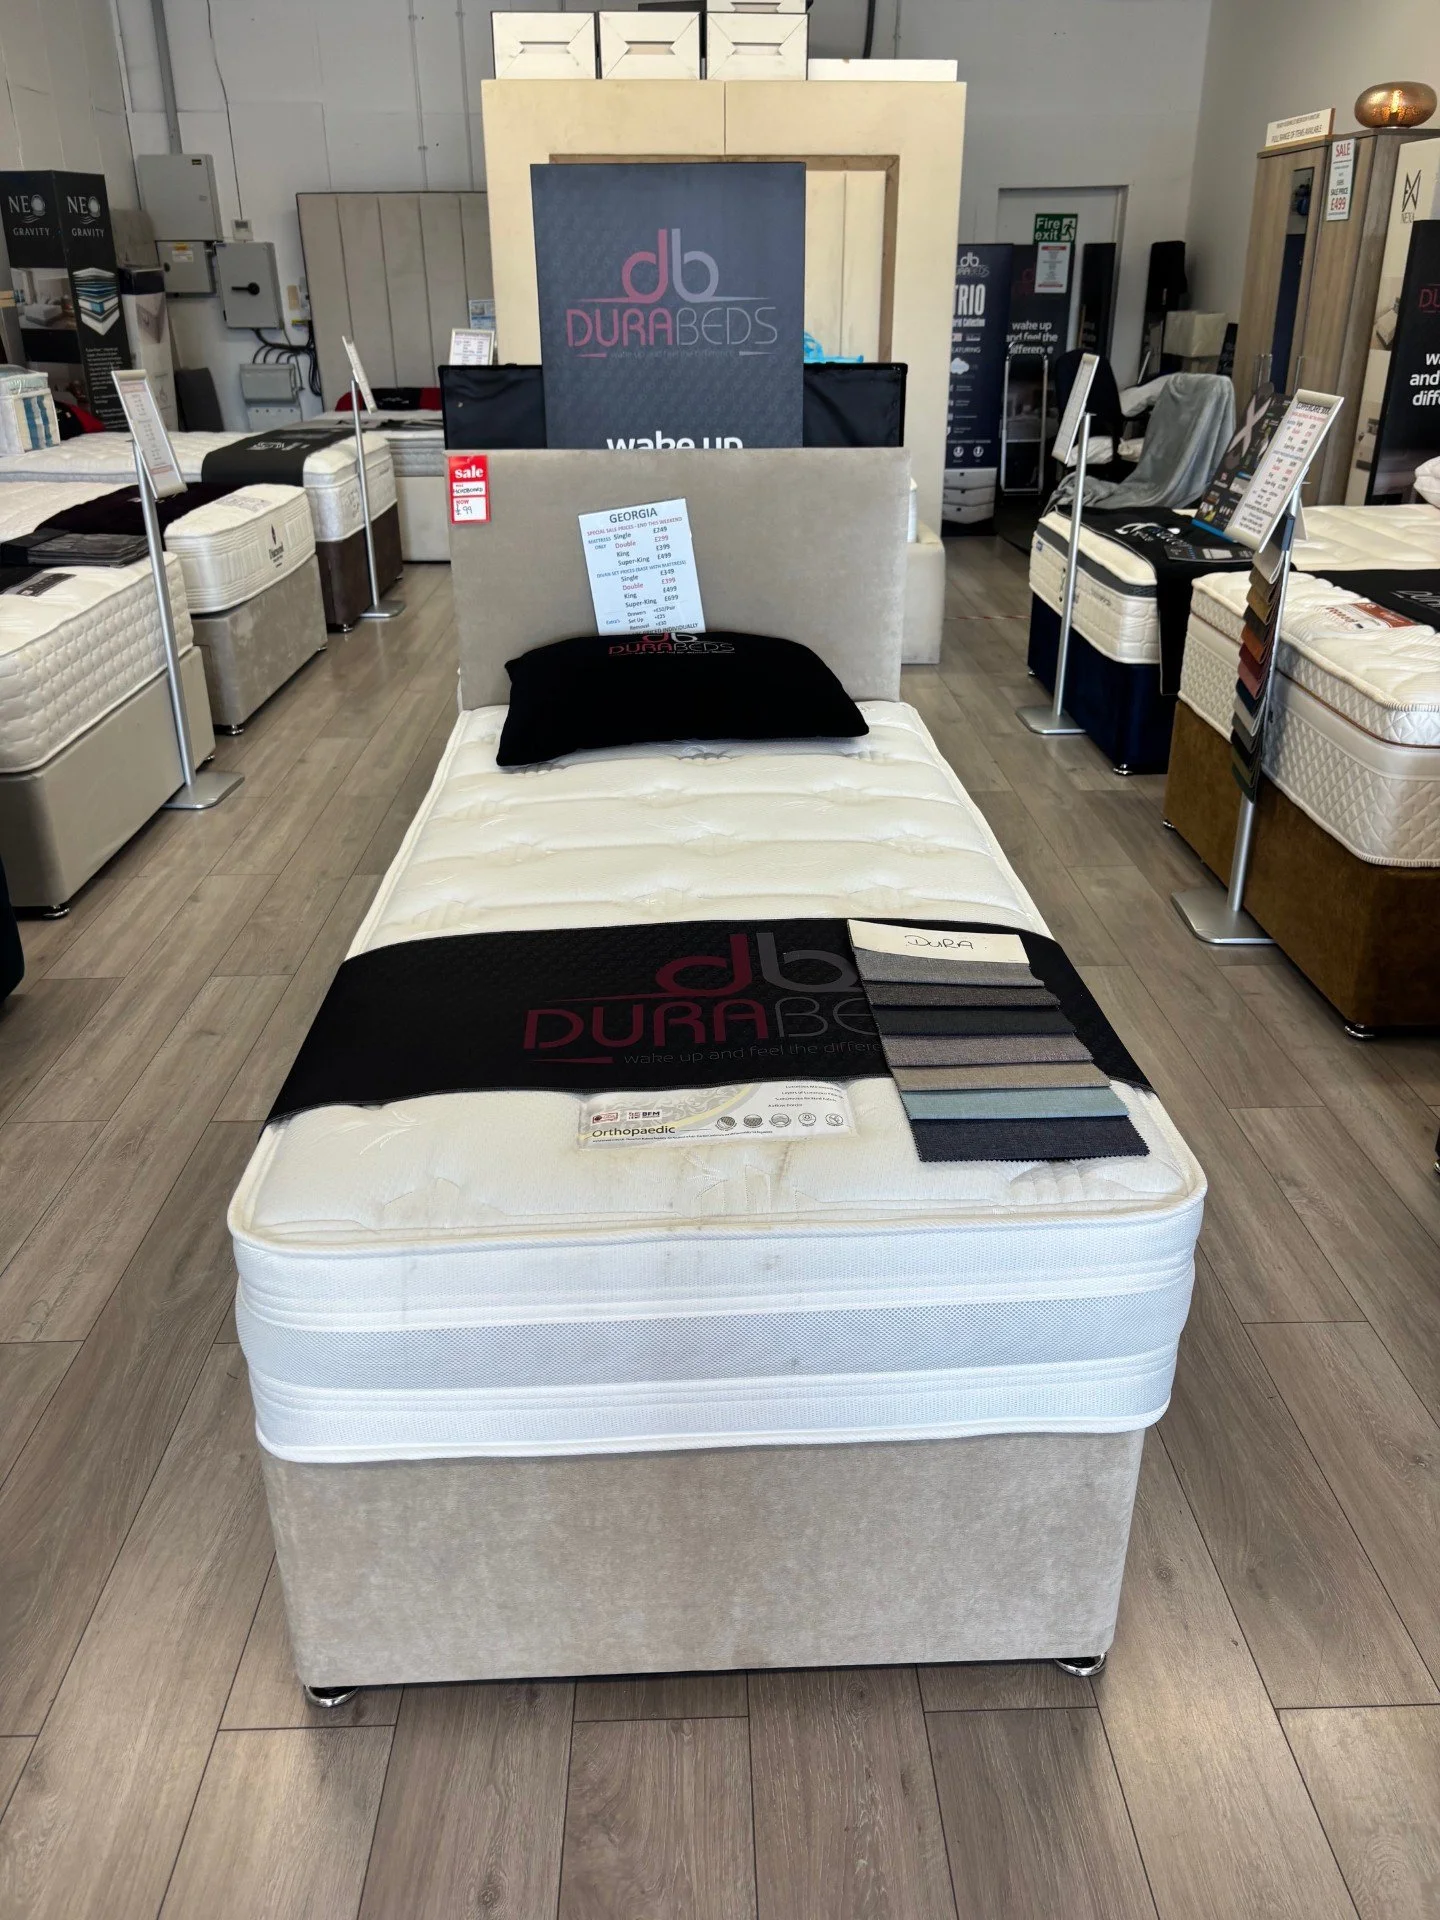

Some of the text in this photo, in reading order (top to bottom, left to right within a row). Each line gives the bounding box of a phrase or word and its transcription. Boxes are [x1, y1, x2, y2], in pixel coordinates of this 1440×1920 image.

[1336, 143, 1351, 157] SALE
[1036, 218, 1060, 229] Fire
[13, 228, 50, 236] GRAVITY
[72, 228, 104, 237] GRAVITY
[1035, 230, 1059, 241] exit
[566, 306, 777, 346] DURABEDS
[1012, 320, 1052, 332] wake up
[1042, 332, 1058, 342] the
[454, 464, 484, 479] sale
[610, 508, 658, 524] GEORGIA
[659, 517, 682, 525] WEEKEND
[614, 532, 631, 541] Single
[615, 541, 636, 549] Double
[618, 556, 650, 566] Super-King
[621, 575, 638, 583] Single
[623, 583, 644, 591] Double
[625, 598, 657, 609] Super-King
[663, 623, 698, 633] INDIVIDUALLY
[608, 642, 735, 655] DURABEDS
[625, 1053, 674, 1064] wake
[680, 1052, 703, 1063] up
[709, 1047, 744, 1060] and
[750, 1045, 784, 1057] feel
[790, 1043, 818, 1055] the
[592, 1126, 676, 1137] Orthopaedic
